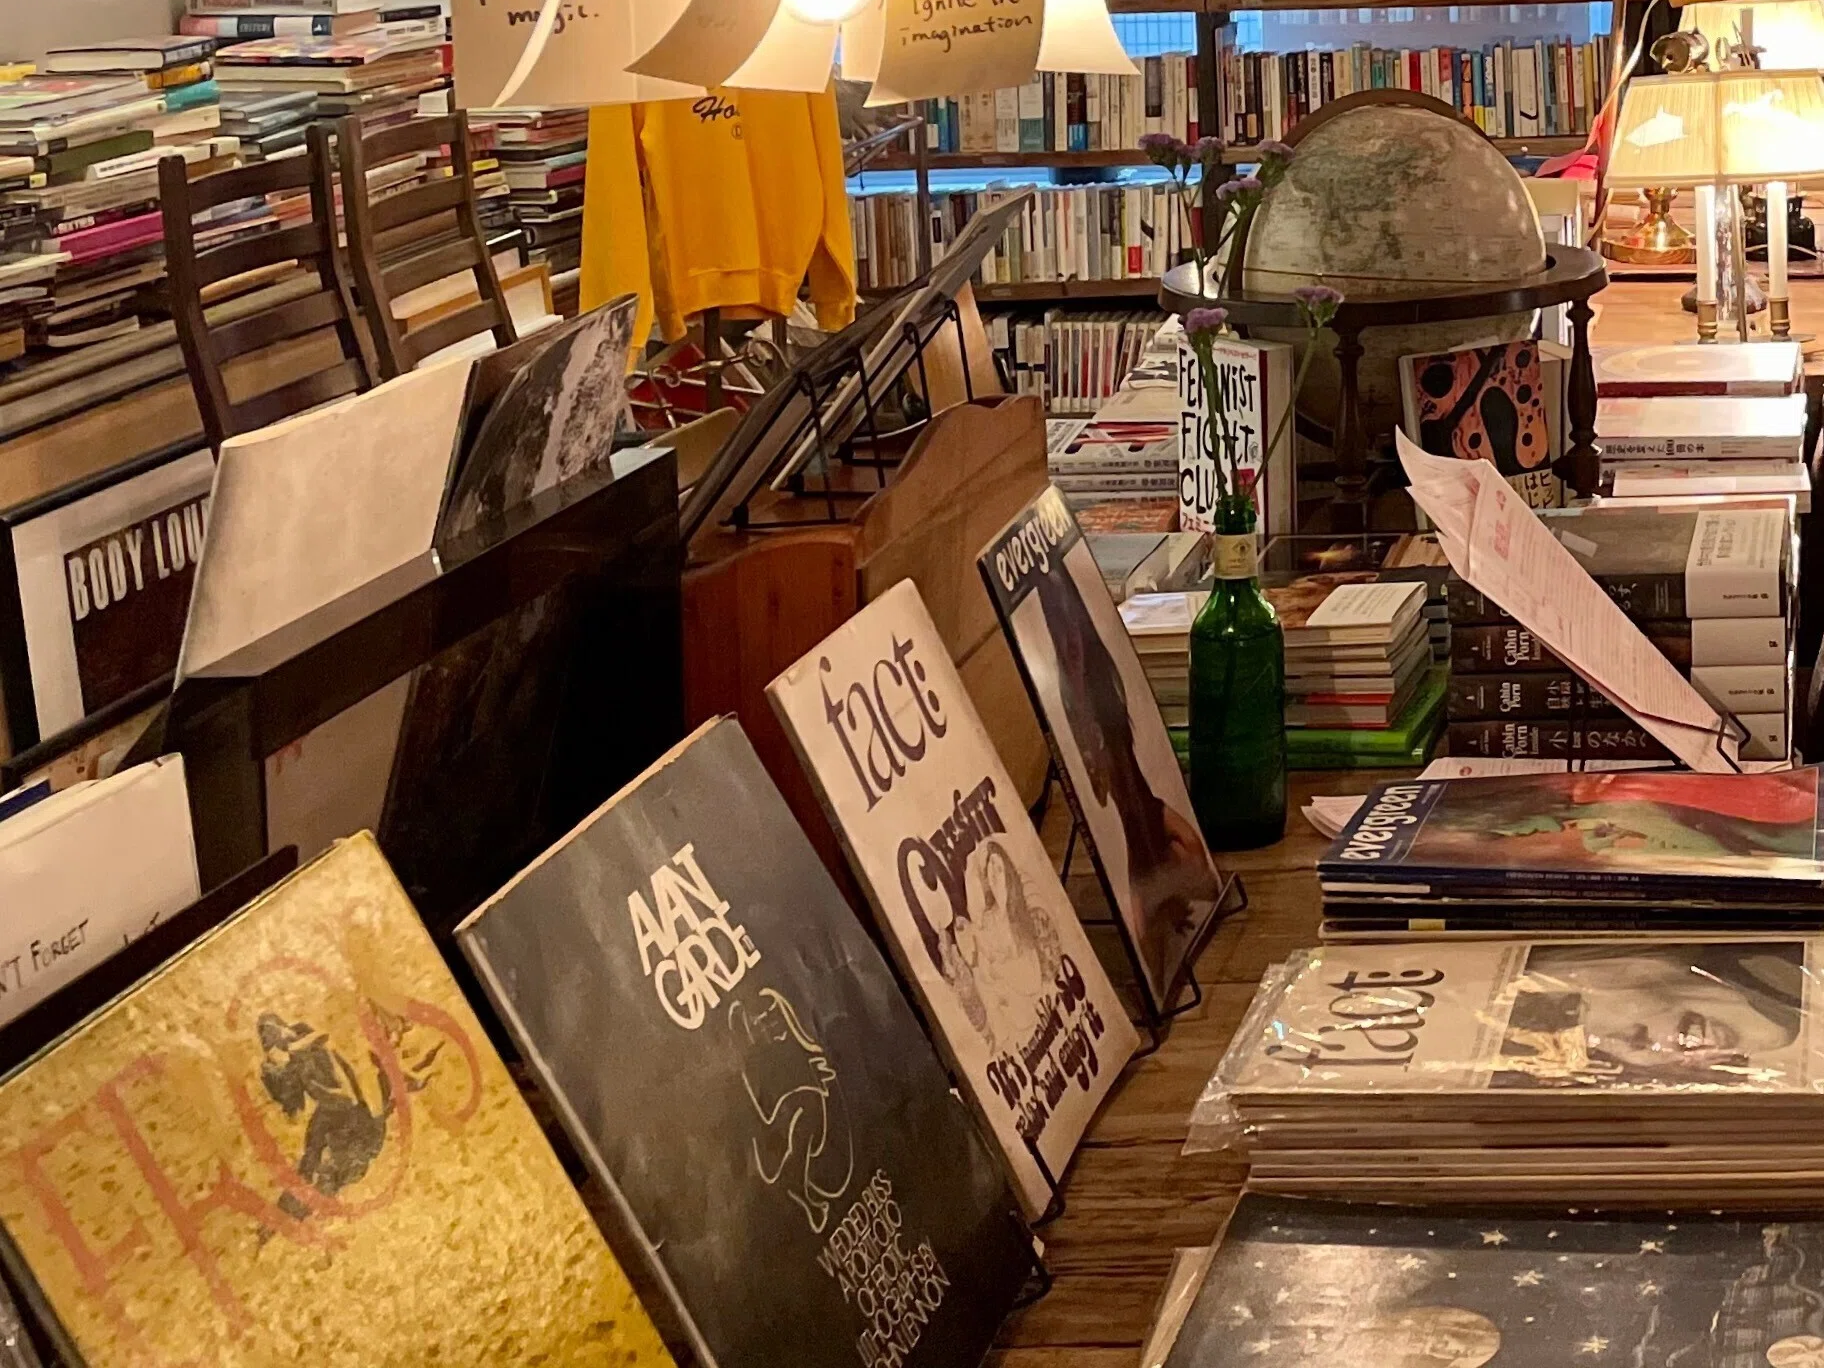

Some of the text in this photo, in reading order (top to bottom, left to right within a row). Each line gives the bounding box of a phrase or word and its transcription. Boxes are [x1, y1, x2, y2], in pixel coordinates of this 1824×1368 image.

[899, 14, 1033, 54] imagination
[68, 527, 145, 622] BODY
[1504, 629, 1518, 666] Cabin
[1517, 631, 1531, 662] Porn
[1500, 682, 1511, 713] Cabin
[1510, 683, 1521, 708] Porn
[1501, 723, 1516, 759] Cabin
[1515, 725, 1528, 755] Porn
[1339, 784, 1424, 861] evergreen
[30, 918, 89, 972] FORGET
[654, 917, 762, 1030] GARDE
[816, 1167, 893, 1277] WEDDED BLISS
[845, 1199, 902, 1292] PORTFOLIO
[870, 1233, 912, 1298] EROTIC
